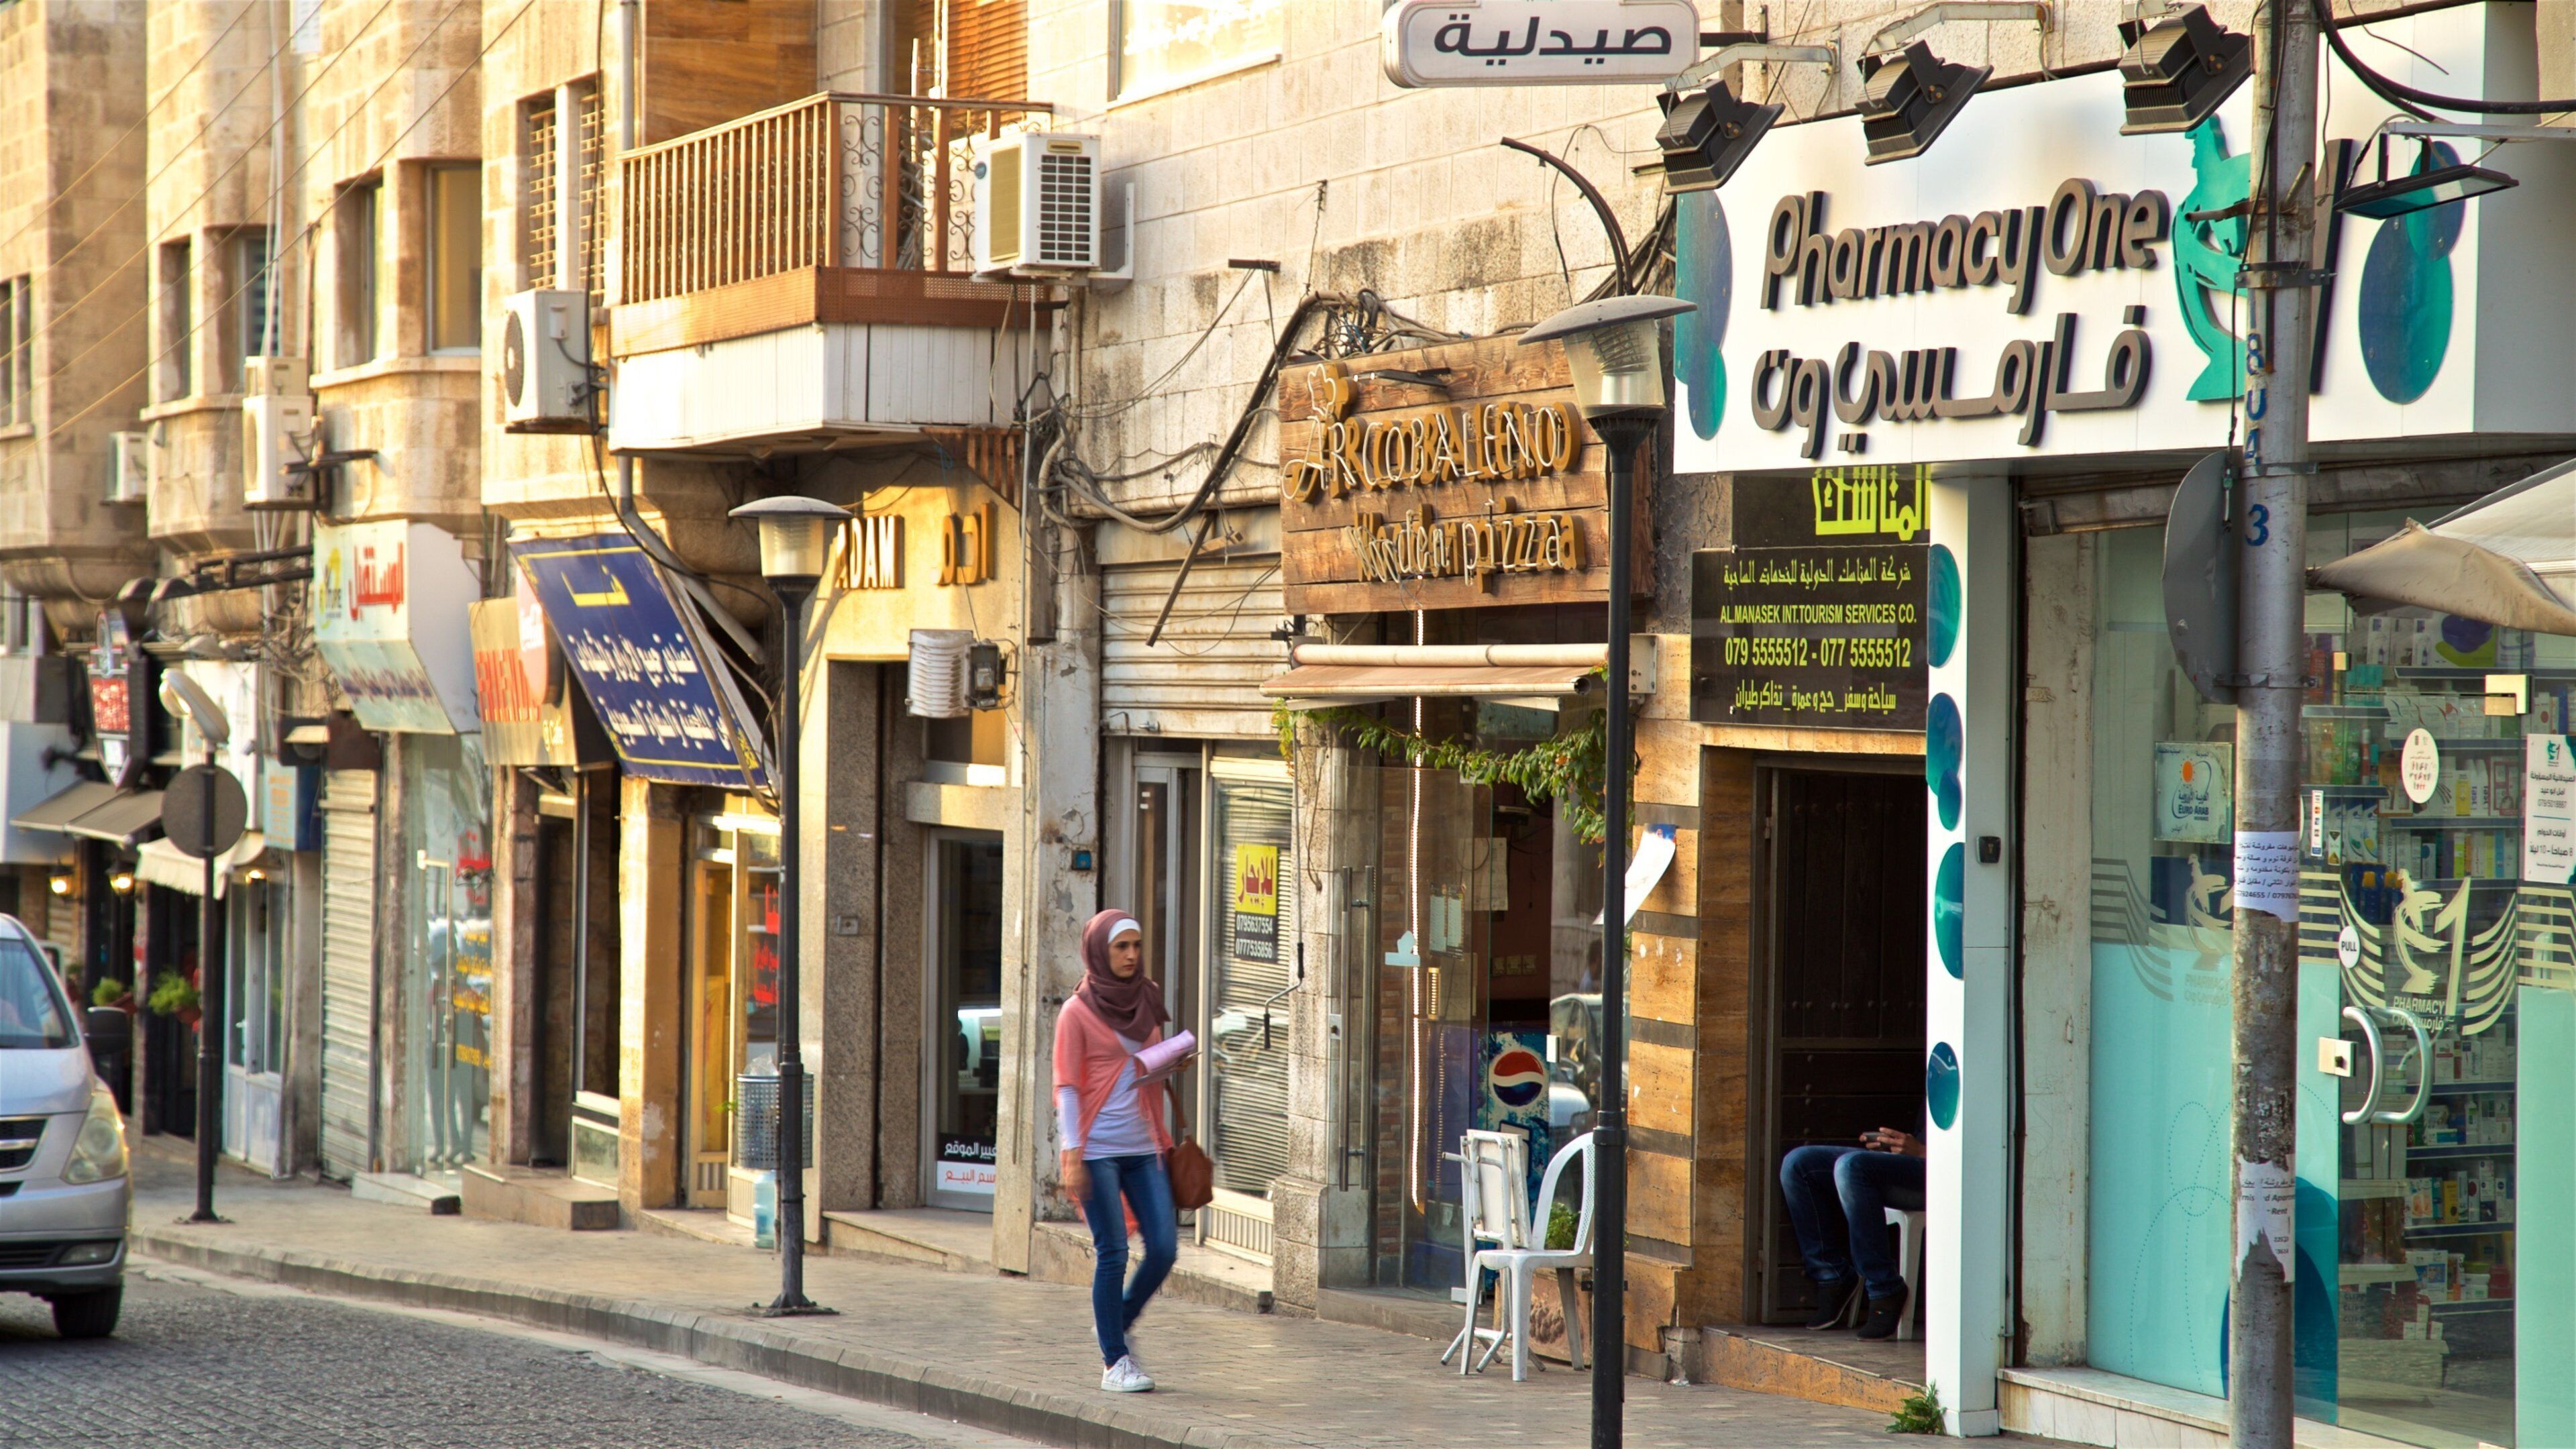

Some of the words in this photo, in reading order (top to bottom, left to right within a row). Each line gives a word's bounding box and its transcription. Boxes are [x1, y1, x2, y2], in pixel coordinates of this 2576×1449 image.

[1434, 13, 1672, 66] صيدلية
[1833, 305, 2152, 452] فارمسي
[1752, 348, 1829, 459] ون
[1281, 402, 1582, 503] ARCOBALENO
[834, 514, 905, 589] ADAM
[1462, 496, 1587, 594] pizza
[1759, 559, 1797, 586] للخدمات
[1800, 557, 1835, 590] الدولية
[1838, 557, 1878, 584] المناسك
[1880, 555, 1911, 590] شركة
[1720, 604, 1781, 623] AL.MANASEK
[1782, 604, 1843, 623] INT.TOURISM
[1845, 604, 1896, 623] SERVICES
[1898, 604, 1917, 623] CO.
[1725, 637, 1749, 666] 079
[1752, 637, 1808, 666] 5555512
[1820, 638, 1846, 667] 077
[1849, 638, 1911, 667] 5555512
[1735, 679, 1758, 710] طيران
[1759, 680, 1782, 710] تذاكر
[1819, 690, 1834, 713] حج
[1868, 682, 1896, 715] سياحة
[1236, 914, 1273, 934] 0795637554
[2341, 941, 2357, 953] PULL
[2393, 996, 2445, 1015] PHARMACY
[944, 1140, 979, 1157] الموقع
